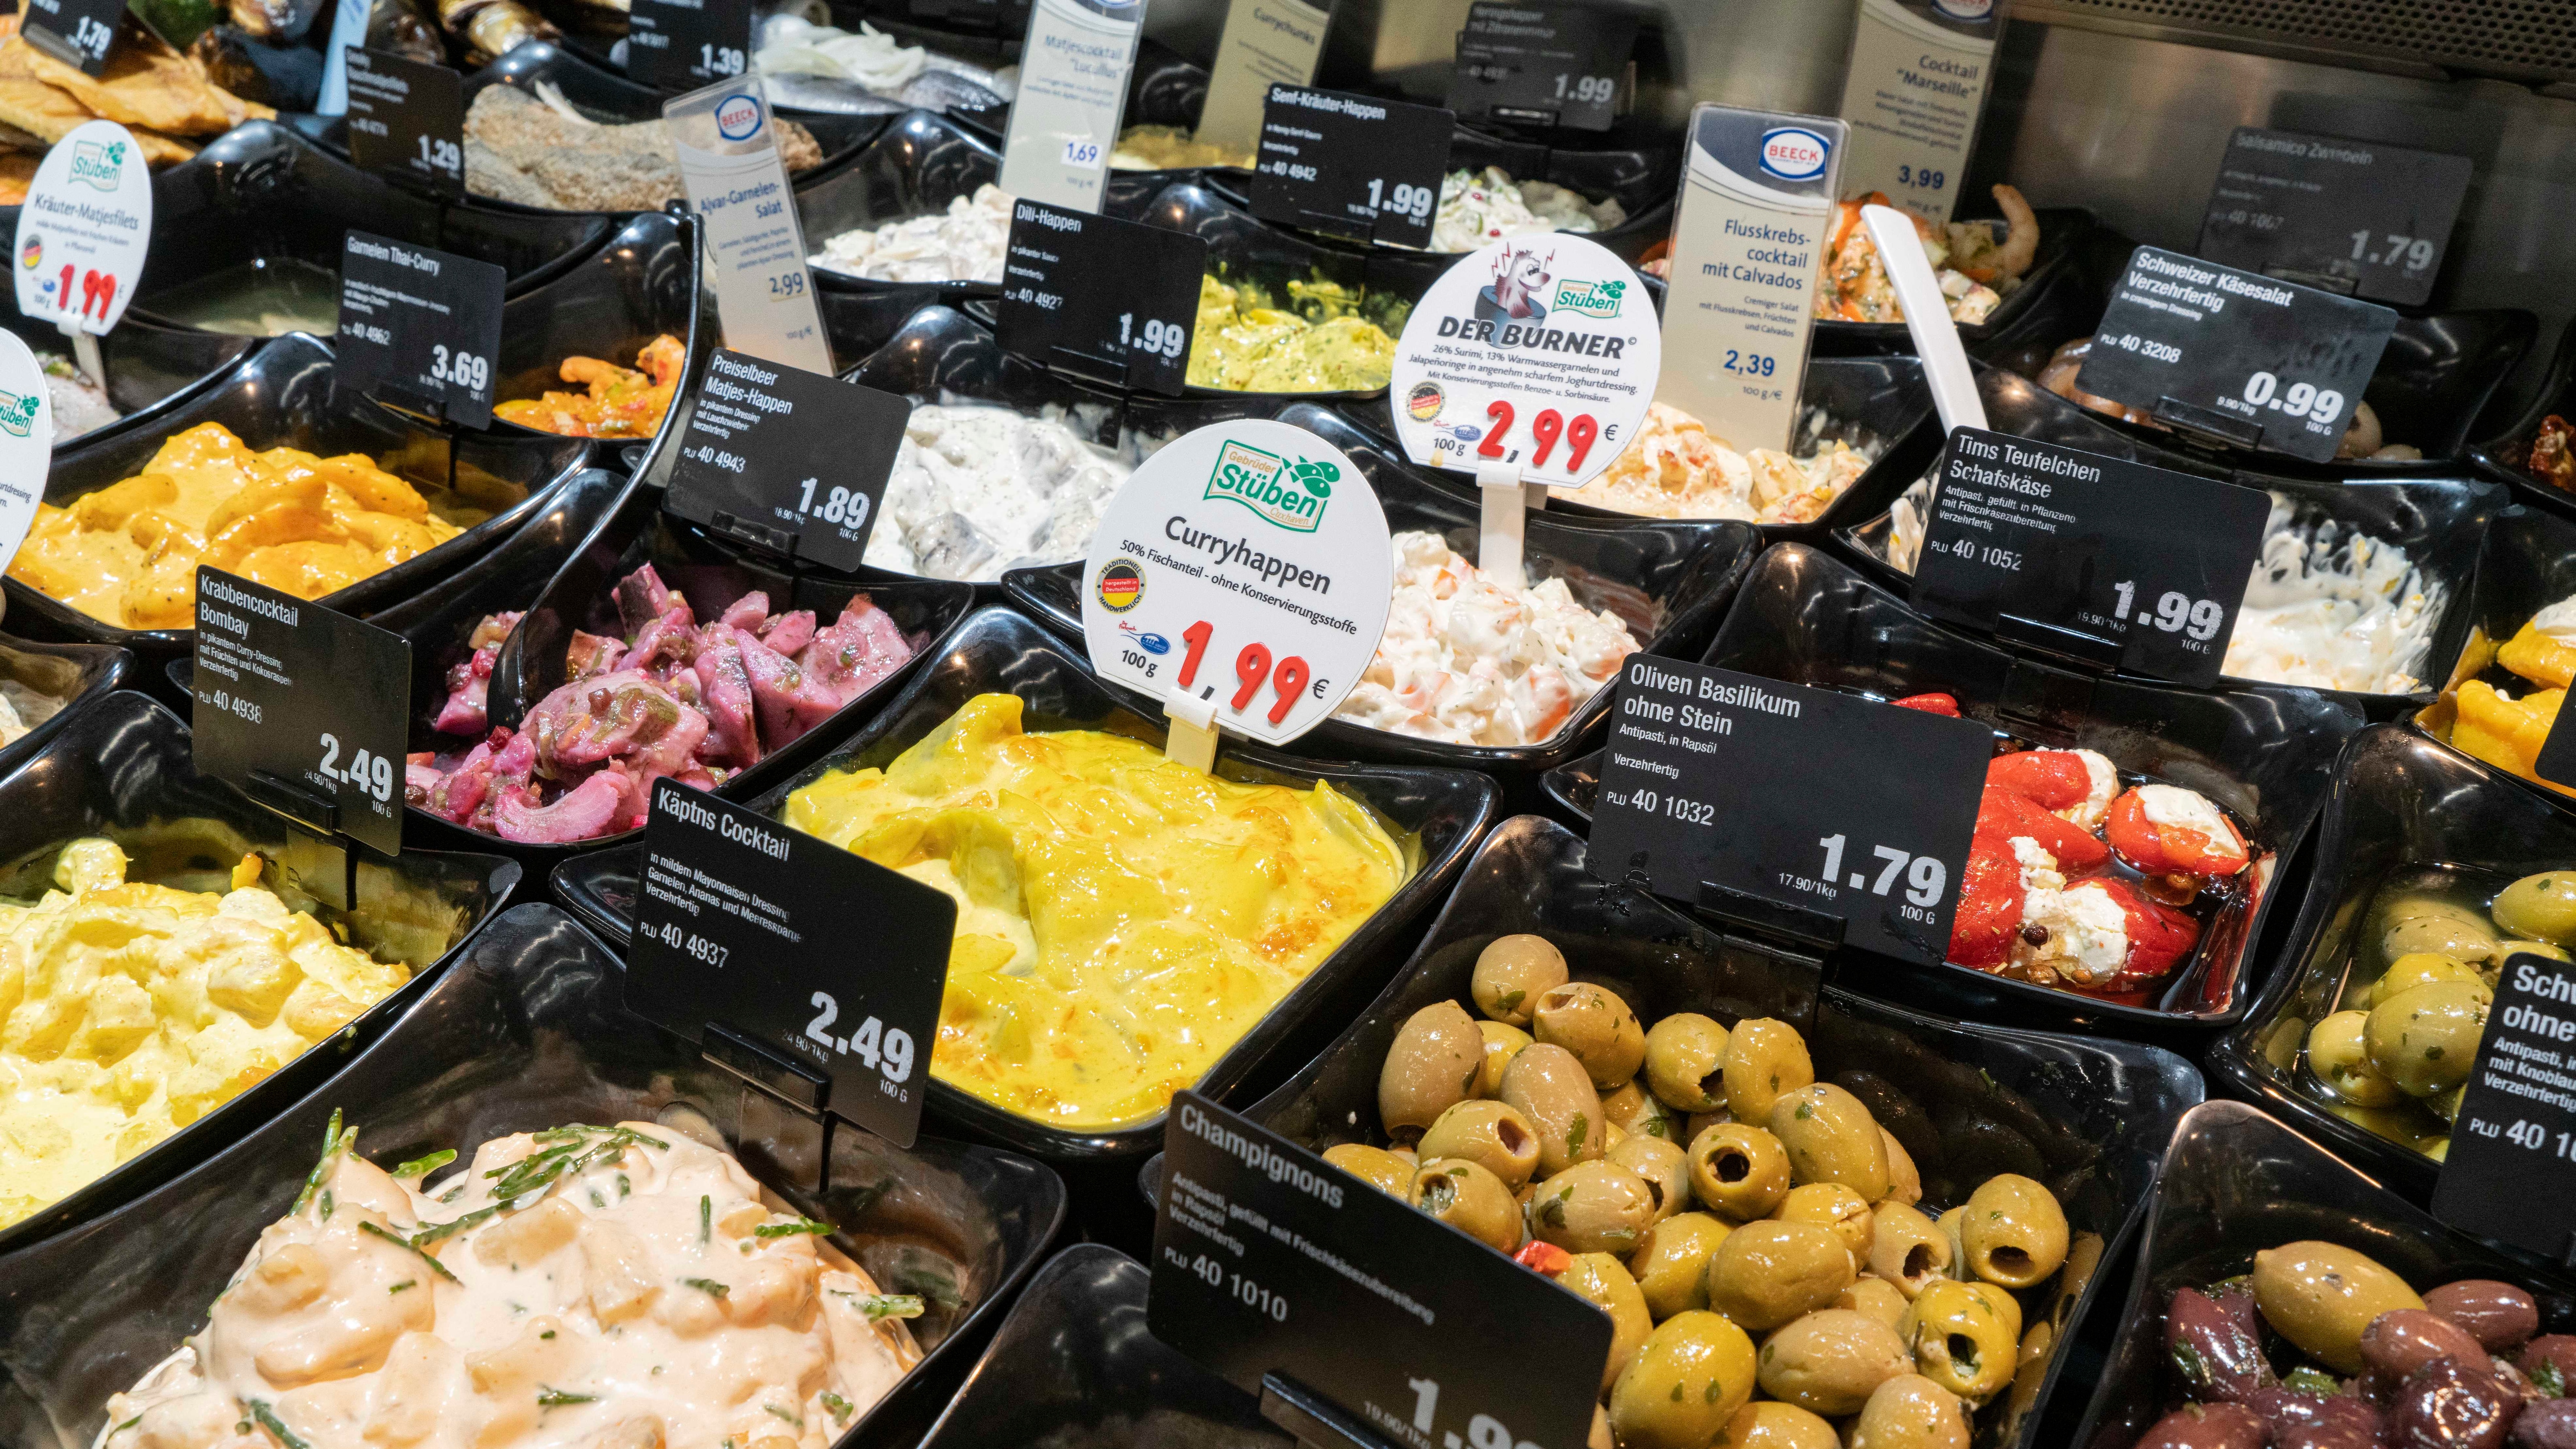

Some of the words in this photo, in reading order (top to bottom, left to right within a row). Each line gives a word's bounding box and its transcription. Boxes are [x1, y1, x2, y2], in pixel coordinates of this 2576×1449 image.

[78, 15, 112, 52] 1.79
[701, 43, 745, 75] 1.39
[1919, 55, 1979, 80] Cocktail
[1272, 88, 1386, 121] Senf-Kräuter-Happen
[1554, 73, 1615, 103] 1.99
[418, 134, 461, 171] 1.29
[1067, 142, 1098, 162] 1,69
[1272, 161, 1287, 176] 40
[1769, 145, 1819, 162] BEECK
[73, 157, 118, 181] Stüben
[1898, 164, 1945, 189] 3,99
[35, 193, 139, 230] Kräuter-Matjesfilets
[700, 182, 779, 214] Ajvar-Garnelen-
[755, 199, 783, 220] Salat
[1367, 178, 1433, 218] 1.99
[1017, 204, 1082, 233] Dill-Happen
[1725, 219, 1811, 245] Flusskrebs-
[347, 236, 389, 261] Garnelen
[391, 246, 440, 277] Thai-Curry
[1747, 247, 1808, 268] cocktail
[2350, 229, 2434, 270] 1.79
[769, 272, 804, 296] 2,99
[1703, 261, 1728, 278] mit
[1733, 265, 1803, 291] Calvados
[2128, 271, 2225, 314] Verzehrfertig
[2136, 251, 2216, 286] Schweizer
[2216, 272, 2294, 308] Käsesalat
[1018, 288, 1032, 303] 40
[1558, 290, 1615, 311] Stüben
[1744, 296, 1778, 311] Cremiger
[1780, 301, 1799, 313] Salat
[352, 322, 365, 338] 40
[1437, 316, 1496, 343] DER
[1713, 302, 1761, 320] Flusskrebsen,
[1764, 313, 1797, 326] Früchten
[1745, 322, 1759, 332] und
[1760, 325, 1794, 338] Calvados
[1120, 312, 1185, 358] 1.99
[2119, 333, 2140, 352] 40
[2141, 340, 2182, 364] 3208
[431, 344, 488, 391] 3.69
[711, 354, 778, 386] Preiselbeer
[1409, 354, 1466, 371] Jalapeñoringe
[1478, 364, 1522, 380] angenehm
[1524, 369, 1564, 385] scharfem
[1565, 374, 1638, 395] Joghurtdressing.
[1433, 344, 1453, 354] 26%
[1454, 347, 1484, 361] Surimi,
[1486, 351, 1505, 362] 13%
[1507, 354, 1600, 374] Warmwassergarnelen
[1602, 367, 1619, 378] und
[1723, 349, 1775, 377] 2,39
[705, 376, 793, 415] Matjes-Happen
[1427, 370, 1440, 379] Mit
[1443, 372, 1522, 392] Konservierungsstoffen
[1524, 384, 1554, 395] Benzoe-
[1564, 389, 1611, 403] Sorbinsäure.
[2243, 370, 2345, 424] 0.99
[706, 400, 734, 416] pikantem
[1433, 437, 1455, 451] 100
[1477, 400, 1598, 472] 2,99
[697, 446, 714, 464] 40
[715, 450, 747, 473] 4943
[1229, 451, 1277, 473] Gebrüder
[1958, 434, 1999, 460] Tims
[2004, 444, 2100, 483] Teufelchen
[0, 481, 31, 503] urtdressing
[1216, 463, 1318, 518] Stüben
[1950, 459, 2052, 499] Schafskäse
[798, 477, 870, 530] 1.89
[1269, 507, 1310, 525] Cuxhaven
[1101, 559, 1142, 574] TRADITIONELL
[1165, 516, 1331, 595] Curryhappen
[1931, 541, 1948, 554] PLU
[1952, 539, 1975, 559] 40
[1982, 545, 2022, 571] 1052
[201, 574, 298, 627] Krabbencocktail
[1099, 594, 1142, 612] HANDWERKLICH
[1120, 540, 1145, 557] 50%
[1147, 549, 1204, 578] Fischanteil
[1211, 573, 1240, 592] ohne
[1241, 583, 1358, 635] Konservierungsstoffe
[200, 603, 249, 640] Bombay
[2113, 579, 2223, 641] 1.99
[207, 632, 236, 652] pikantem
[236, 642, 283, 671] Curry-Dressing
[211, 646, 238, 666] Früchten
[1122, 650, 1146, 669] 100
[199, 657, 238, 682] Verzehrfertig
[1177, 619, 1311, 726] 1,99
[1312, 678, 1330, 700] €
[213, 689, 229, 710] 40
[232, 697, 262, 725] 4938
[1630, 662, 1692, 695] Oliven
[1698, 676, 1801, 719] Basilikum
[1624, 695, 1674, 722] ohne
[1680, 705, 1732, 736] Stein
[1619, 723, 1666, 745] Antipasti,
[1682, 735, 1717, 755] Rapsöl
[319, 732, 393, 802] 2.49
[1614, 753, 1680, 779] Verzehrfertig
[371, 799, 385, 816] 100
[1606, 791, 1626, 806] PLU
[1631, 788, 1657, 813] 40
[1665, 795, 1715, 826] 1032
[658, 787, 716, 831] Käptns
[721, 813, 790, 862] Cocktail
[660, 856, 692, 879] mildem
[694, 868, 750, 904] Mayonnaisen
[1778, 873, 1837, 900] 17.90/1kg
[1819, 832, 1947, 908] 1.79
[646, 881, 700, 917] Verzehrfertig
[648, 866, 688, 895] Garnelen,
[689, 882, 720, 908] Ananas
[723, 898, 740, 915] und
[1900, 905, 1923, 923] 100
[640, 922, 657, 939] PLU
[660, 923, 682, 950] 40
[686, 933, 730, 969] 4937
[805, 991, 915, 1083] 2.49
[2503, 1004, 2576, 1043] ohne
[2489, 1055, 2515, 1075] mit
[2493, 1036, 2562, 1071] Antipasti,
[879, 1078, 898, 1099] 100
[2484, 1071, 2576, 1114] Verzehrfertig
[2469, 1117, 2500, 1139] PLU
[2506, 1119, 2547, 1151] 40
[1180, 1103, 1345, 1210] Champignons
[1184, 1196, 1226, 1228] Rapsöl
[1168, 1204, 1245, 1258] Verzehrfertig
[1172, 1171, 1226, 1211] Antipasti,
[1229, 1203, 1268, 1236] gefüllt
[1292, 1232, 1435, 1327] Frischkäsezubereitung
[1164, 1246, 1188, 1270] PLU
[1192, 1254, 1223, 1288] 40
[1231, 1273, 1288, 1323] 1010
[1408, 1375, 1548, 1449] 1.9
